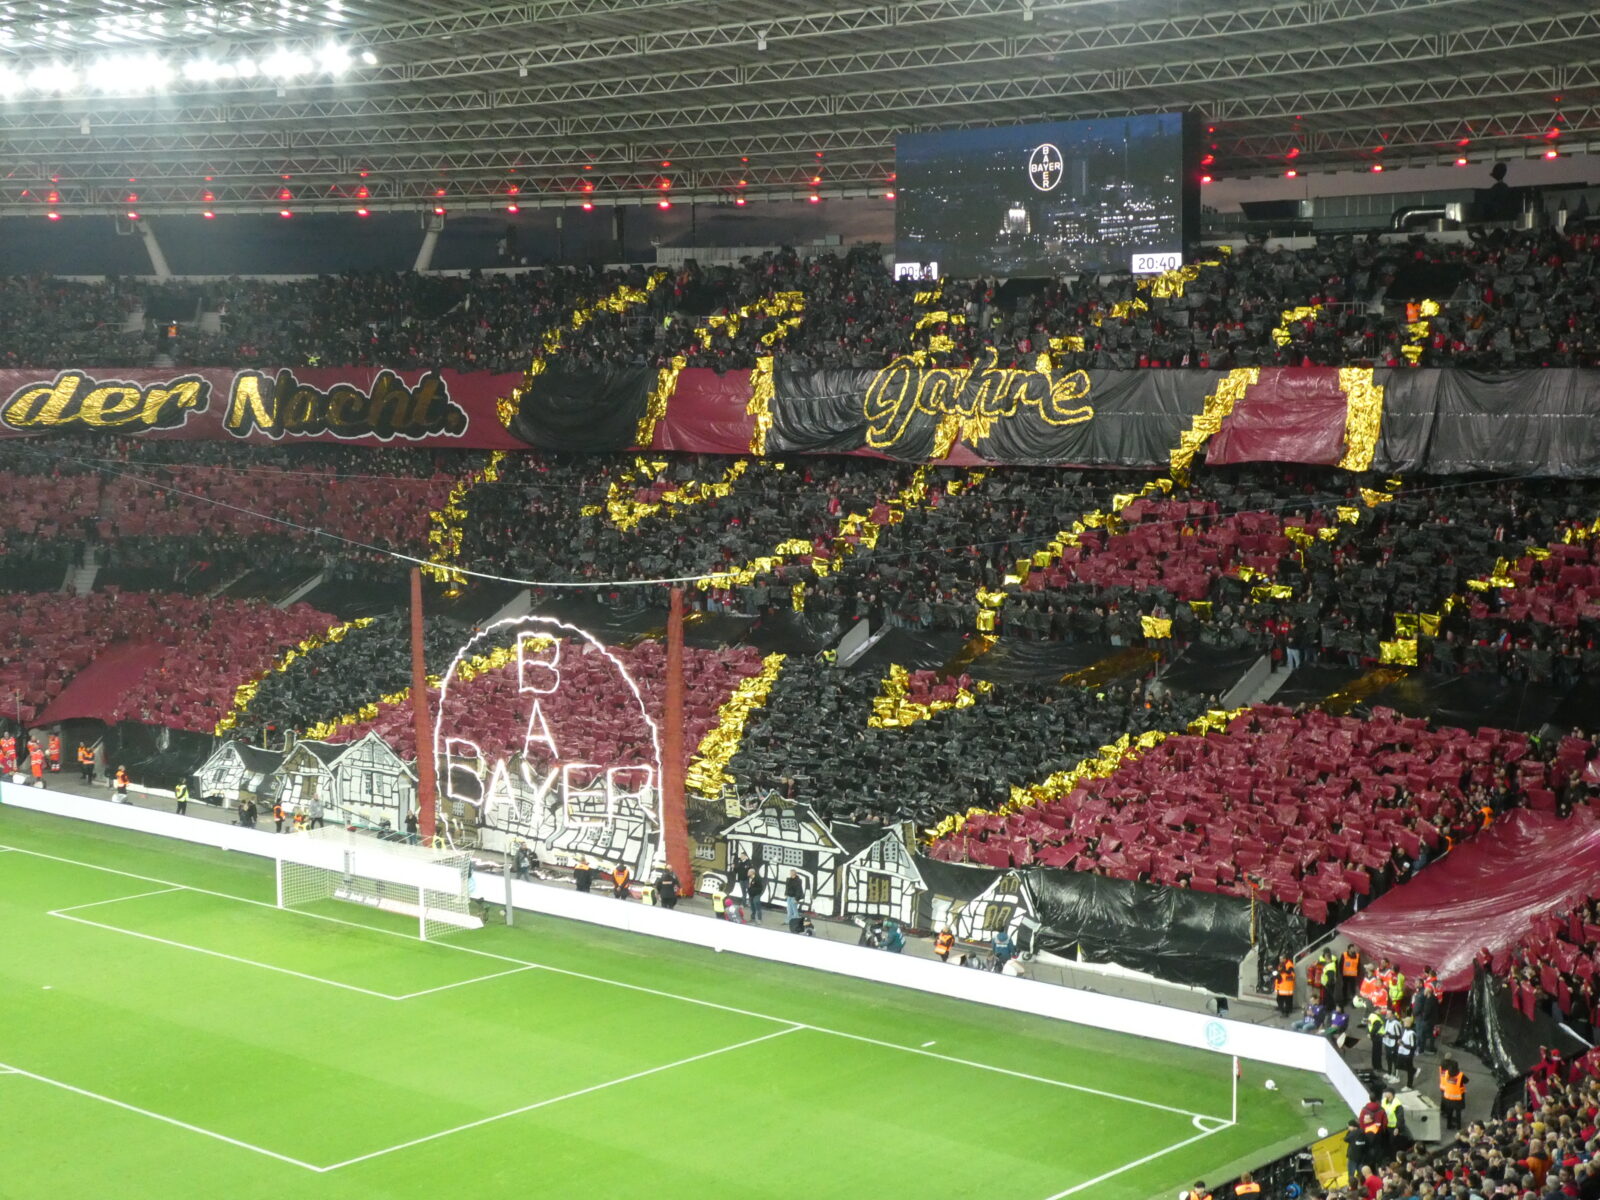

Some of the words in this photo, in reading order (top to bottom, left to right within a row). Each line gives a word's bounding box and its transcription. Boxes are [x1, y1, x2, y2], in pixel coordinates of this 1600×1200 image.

[1031, 161, 1061, 173] BAYER
[1138, 256, 1176, 270] 20:40
[5, 375, 201, 427] der
